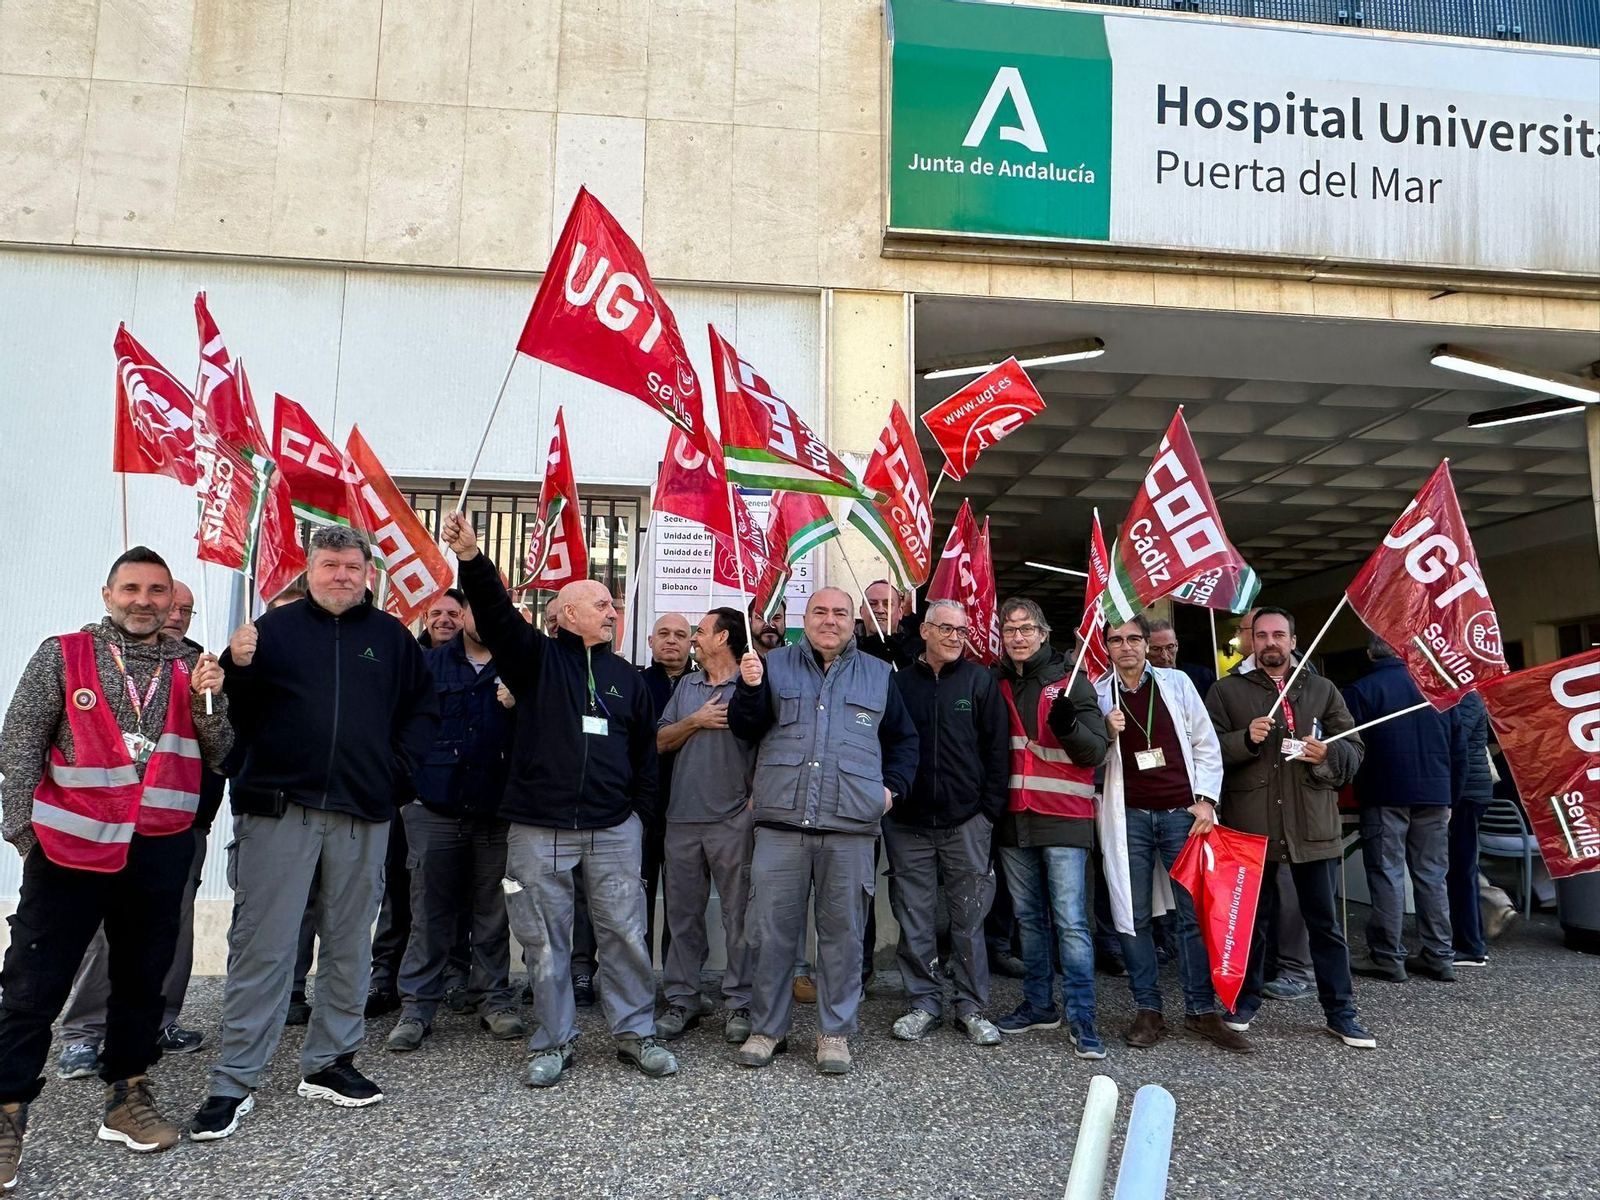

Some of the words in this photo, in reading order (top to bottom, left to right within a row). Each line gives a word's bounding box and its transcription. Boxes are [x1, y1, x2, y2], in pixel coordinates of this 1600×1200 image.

[1157, 83, 1363, 143] Hospital
[1379, 102, 1600, 158] Universit
[908, 153, 965, 174] Junta
[970, 157, 994, 176] de
[998, 160, 1096, 184] Andalucía
[1156, 150, 1285, 193] Puerta
[1299, 159, 1358, 199] del
[1372, 166, 1443, 204] Mar
[943, 374, 1012, 427] www.ugt.es
[663, 532, 692, 540] Unidad
[693, 532, 703, 541] de
[663, 548, 691, 556] Unidad
[891, 506, 927, 569] Cádiz
[1130, 518, 1171, 588] Cádiz
[662, 566, 690, 574] Unidad
[692, 567, 702, 575] de
[662, 583, 698, 591] Biobanco
[800, 567, 807, 577] 5
[1423, 622, 1476, 685] Sevilla
[1563, 790, 1600, 859] Sevilla
